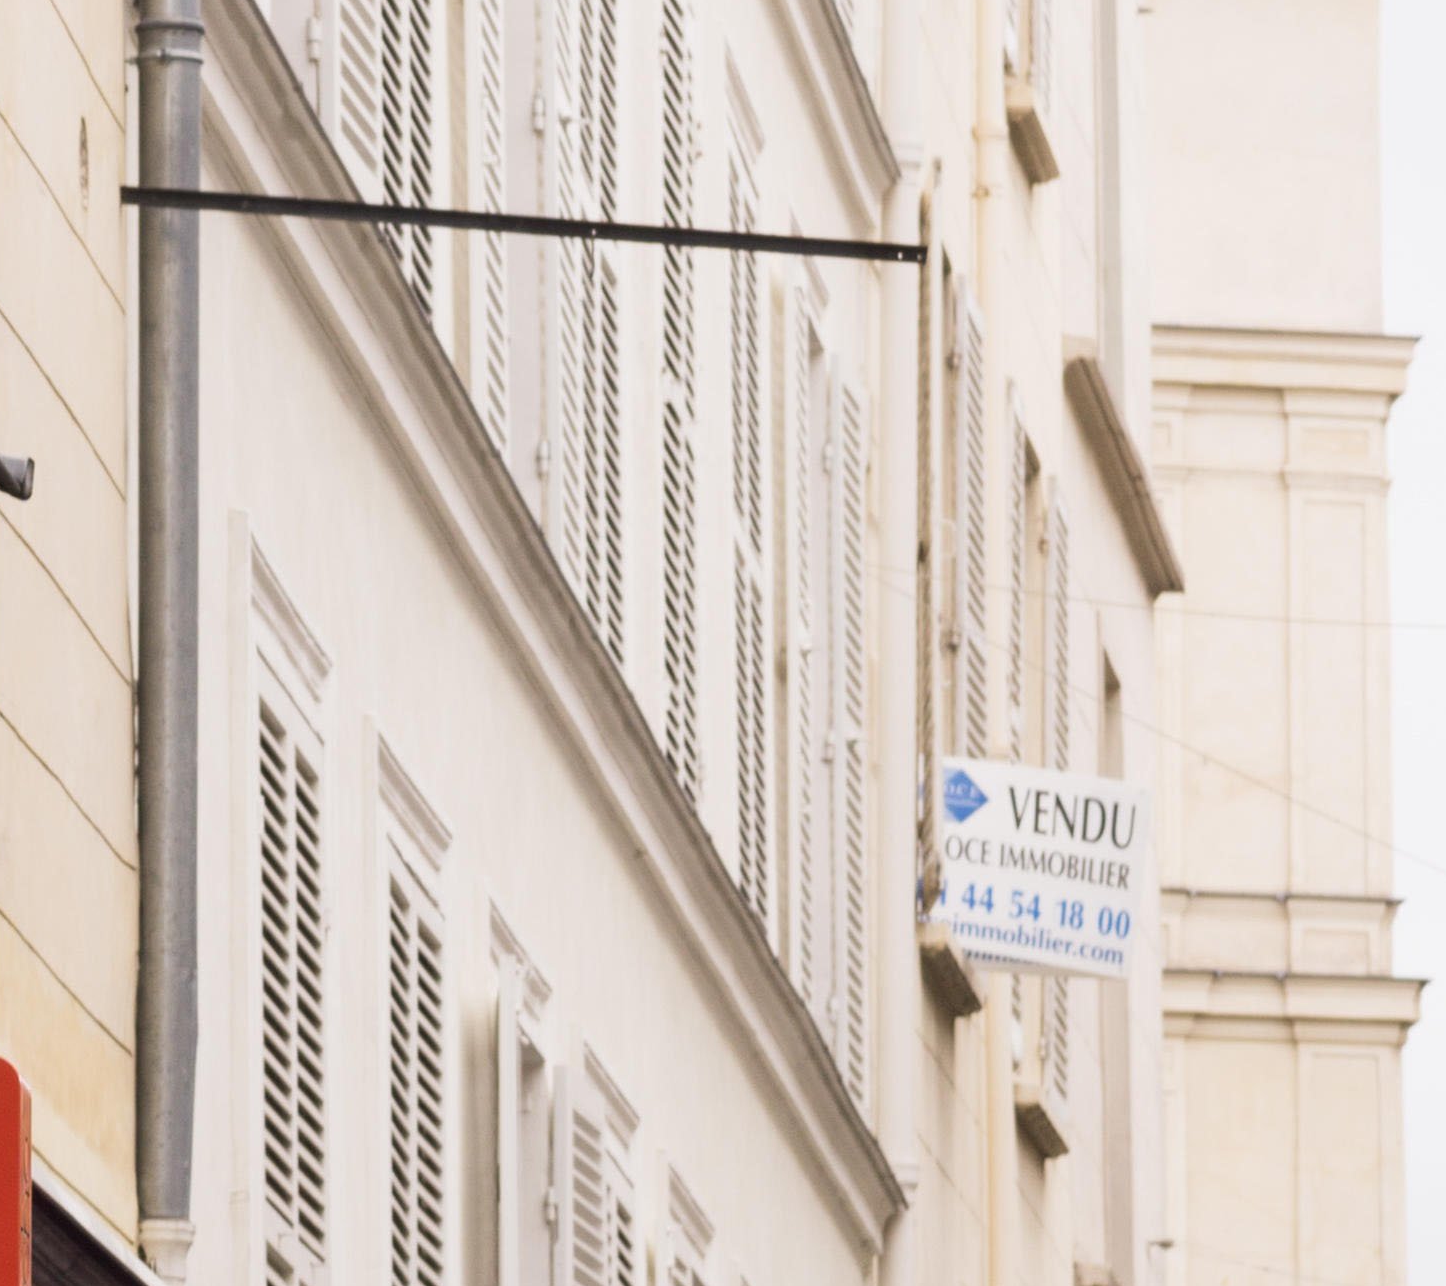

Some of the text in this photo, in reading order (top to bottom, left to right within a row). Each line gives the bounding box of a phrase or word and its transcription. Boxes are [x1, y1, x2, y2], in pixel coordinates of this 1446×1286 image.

[1008, 786, 1136, 850] VENDU
[999, 843, 1130, 891] IMMOBILIER
[961, 881, 995, 914] 44
[1010, 889, 1041, 922] 54
[1057, 897, 1085, 931] 18
[1097, 905, 1131, 940] 00
